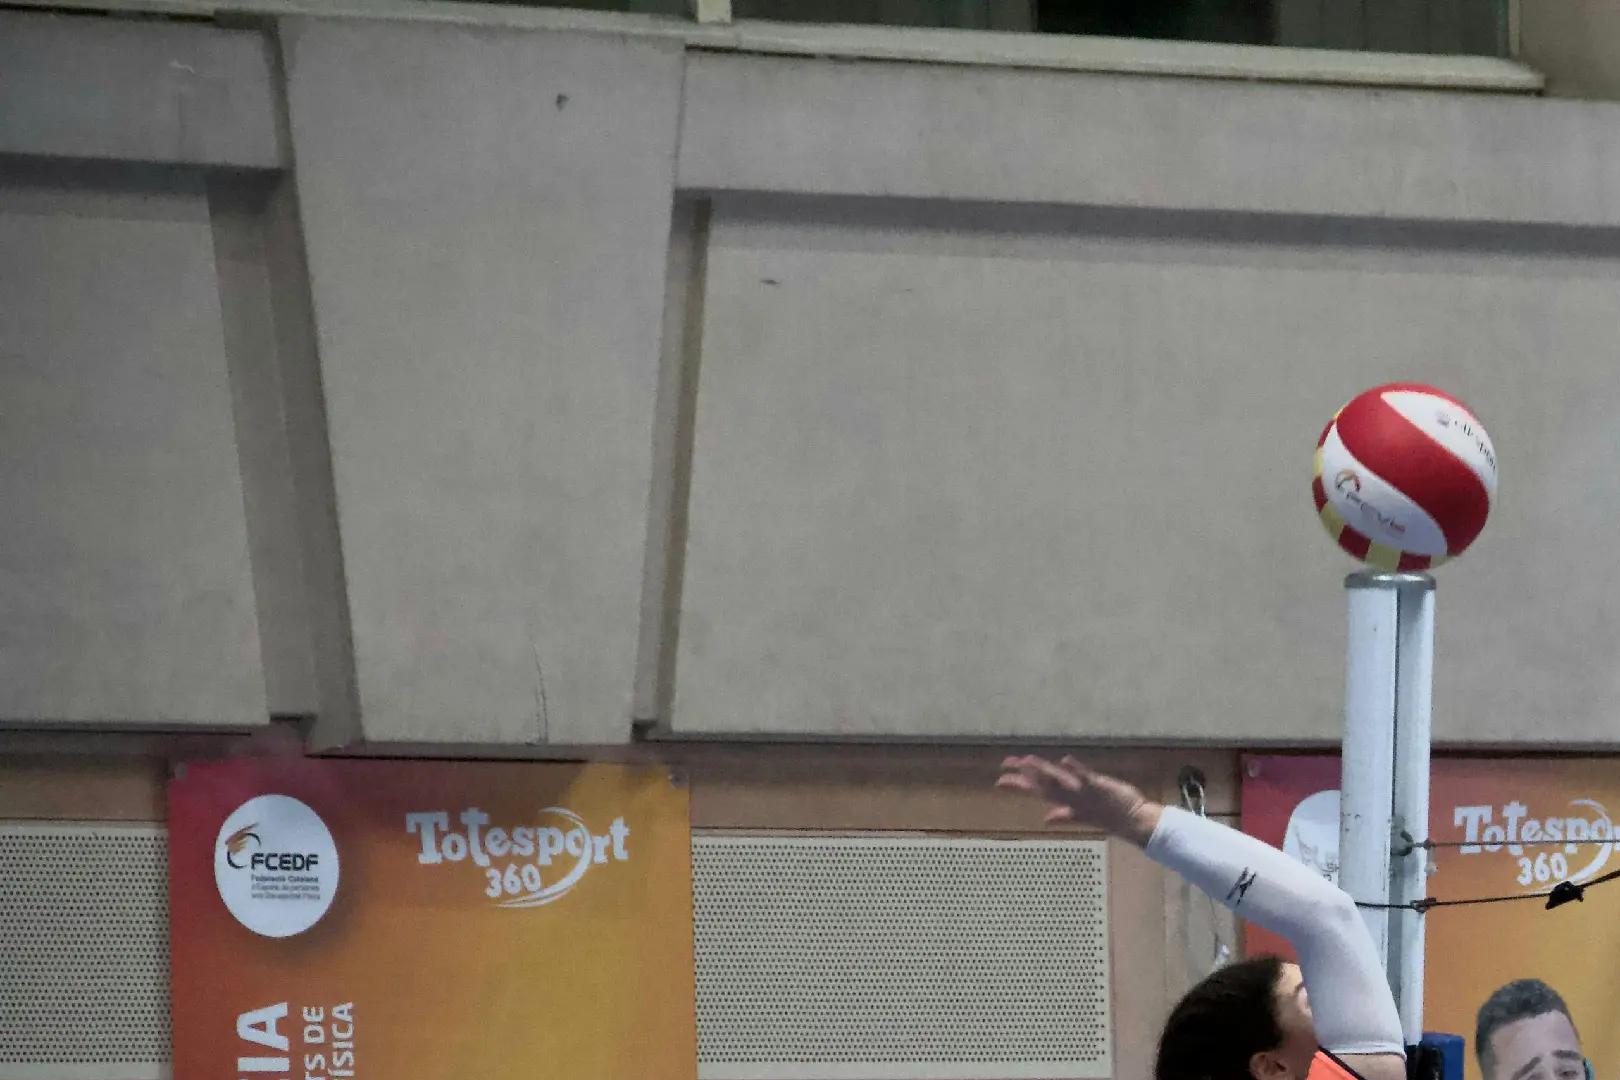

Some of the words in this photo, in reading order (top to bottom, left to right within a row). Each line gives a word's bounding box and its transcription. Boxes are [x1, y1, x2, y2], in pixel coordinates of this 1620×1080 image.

[406, 807, 631, 867] Totesport
[251, 853, 319, 871] FCEDF
[1517, 852, 1567, 885] 360
[485, 863, 541, 898] 360
[302, 1006, 325, 1043] DE
